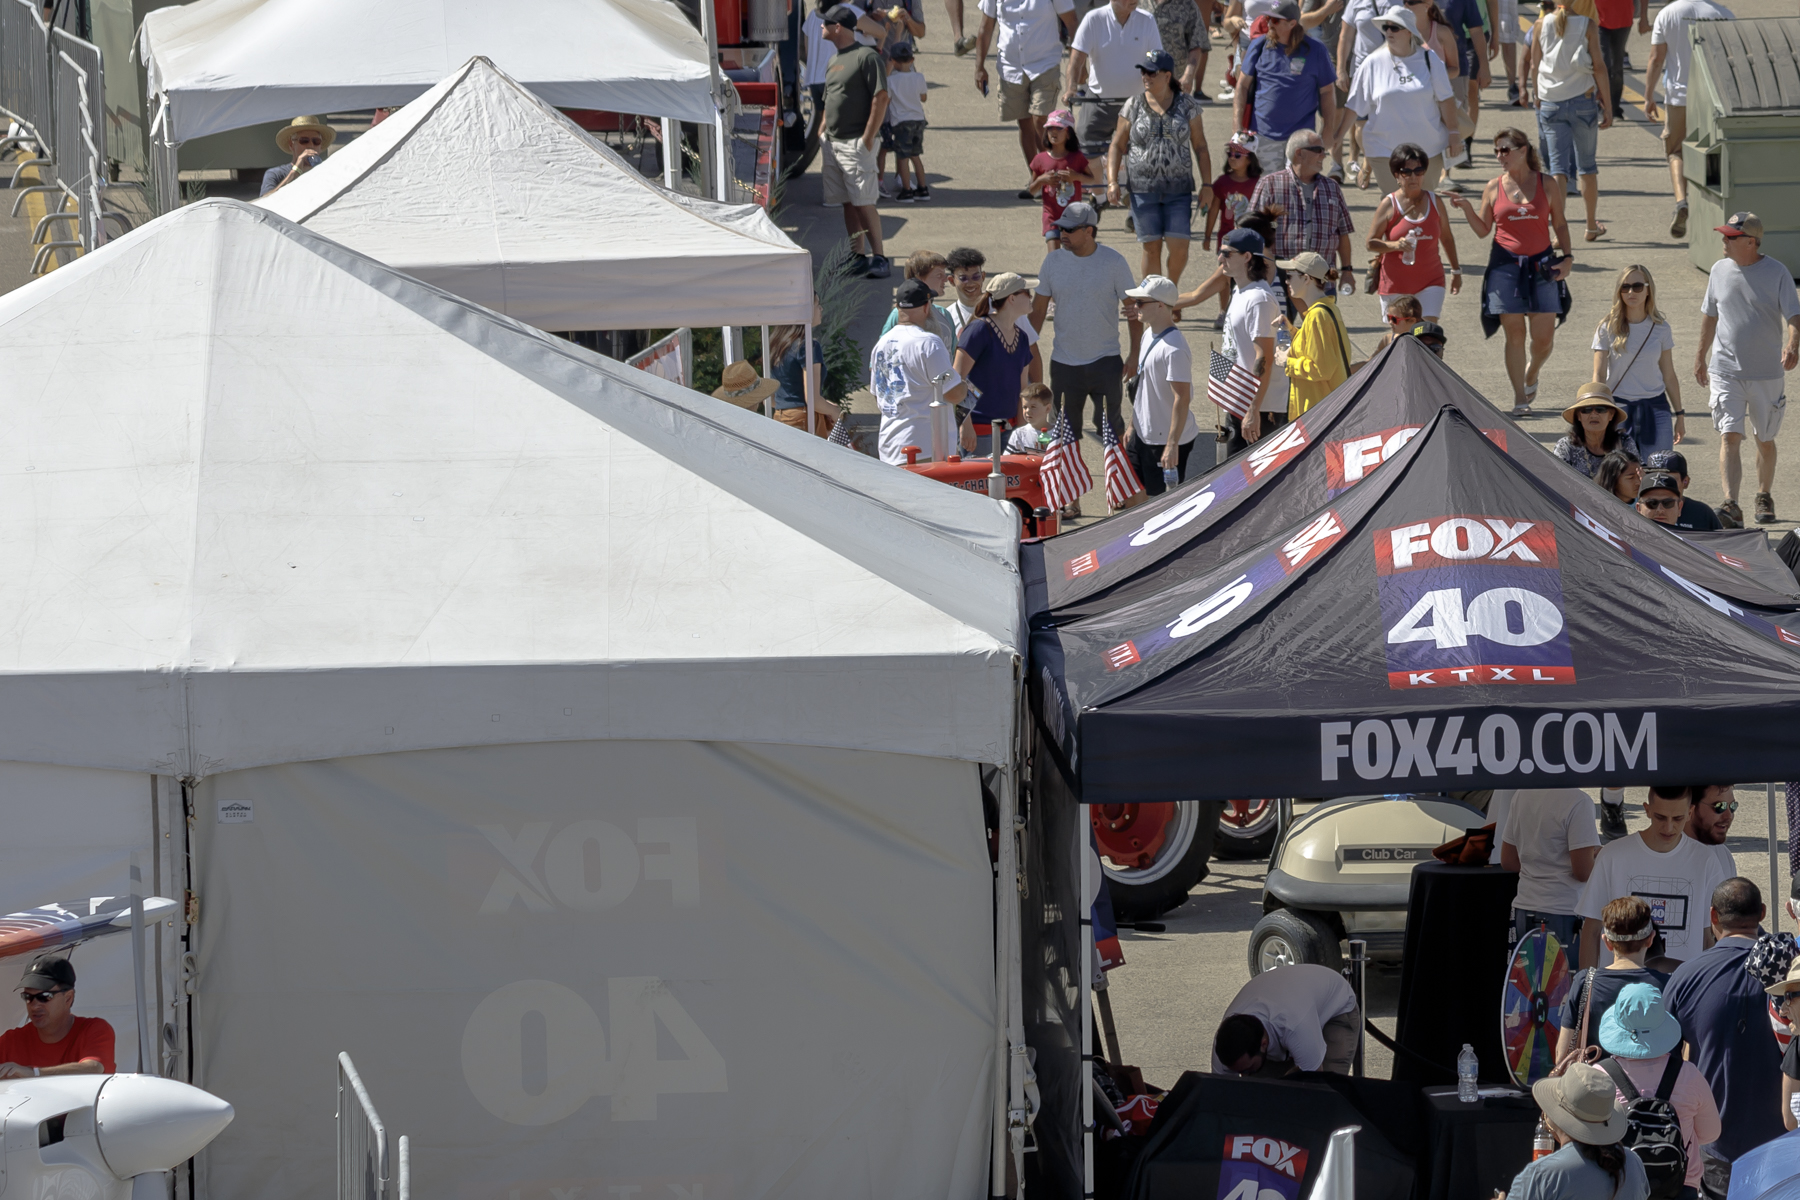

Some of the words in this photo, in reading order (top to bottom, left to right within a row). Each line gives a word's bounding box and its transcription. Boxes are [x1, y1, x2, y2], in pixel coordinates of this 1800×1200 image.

[1391, 517, 1542, 570] FOX
[1387, 587, 1564, 650] 40
[1408, 667, 1555, 686] KTXL
[1321, 712, 1659, 781] FOX40.COM
[1362, 849, 1391, 860] Club
[1394, 848, 1417, 860] Car
[1651, 908, 1666, 919] 40
[1652, 899, 1667, 907] FOX
[1231, 1135, 1301, 1178] FOX
